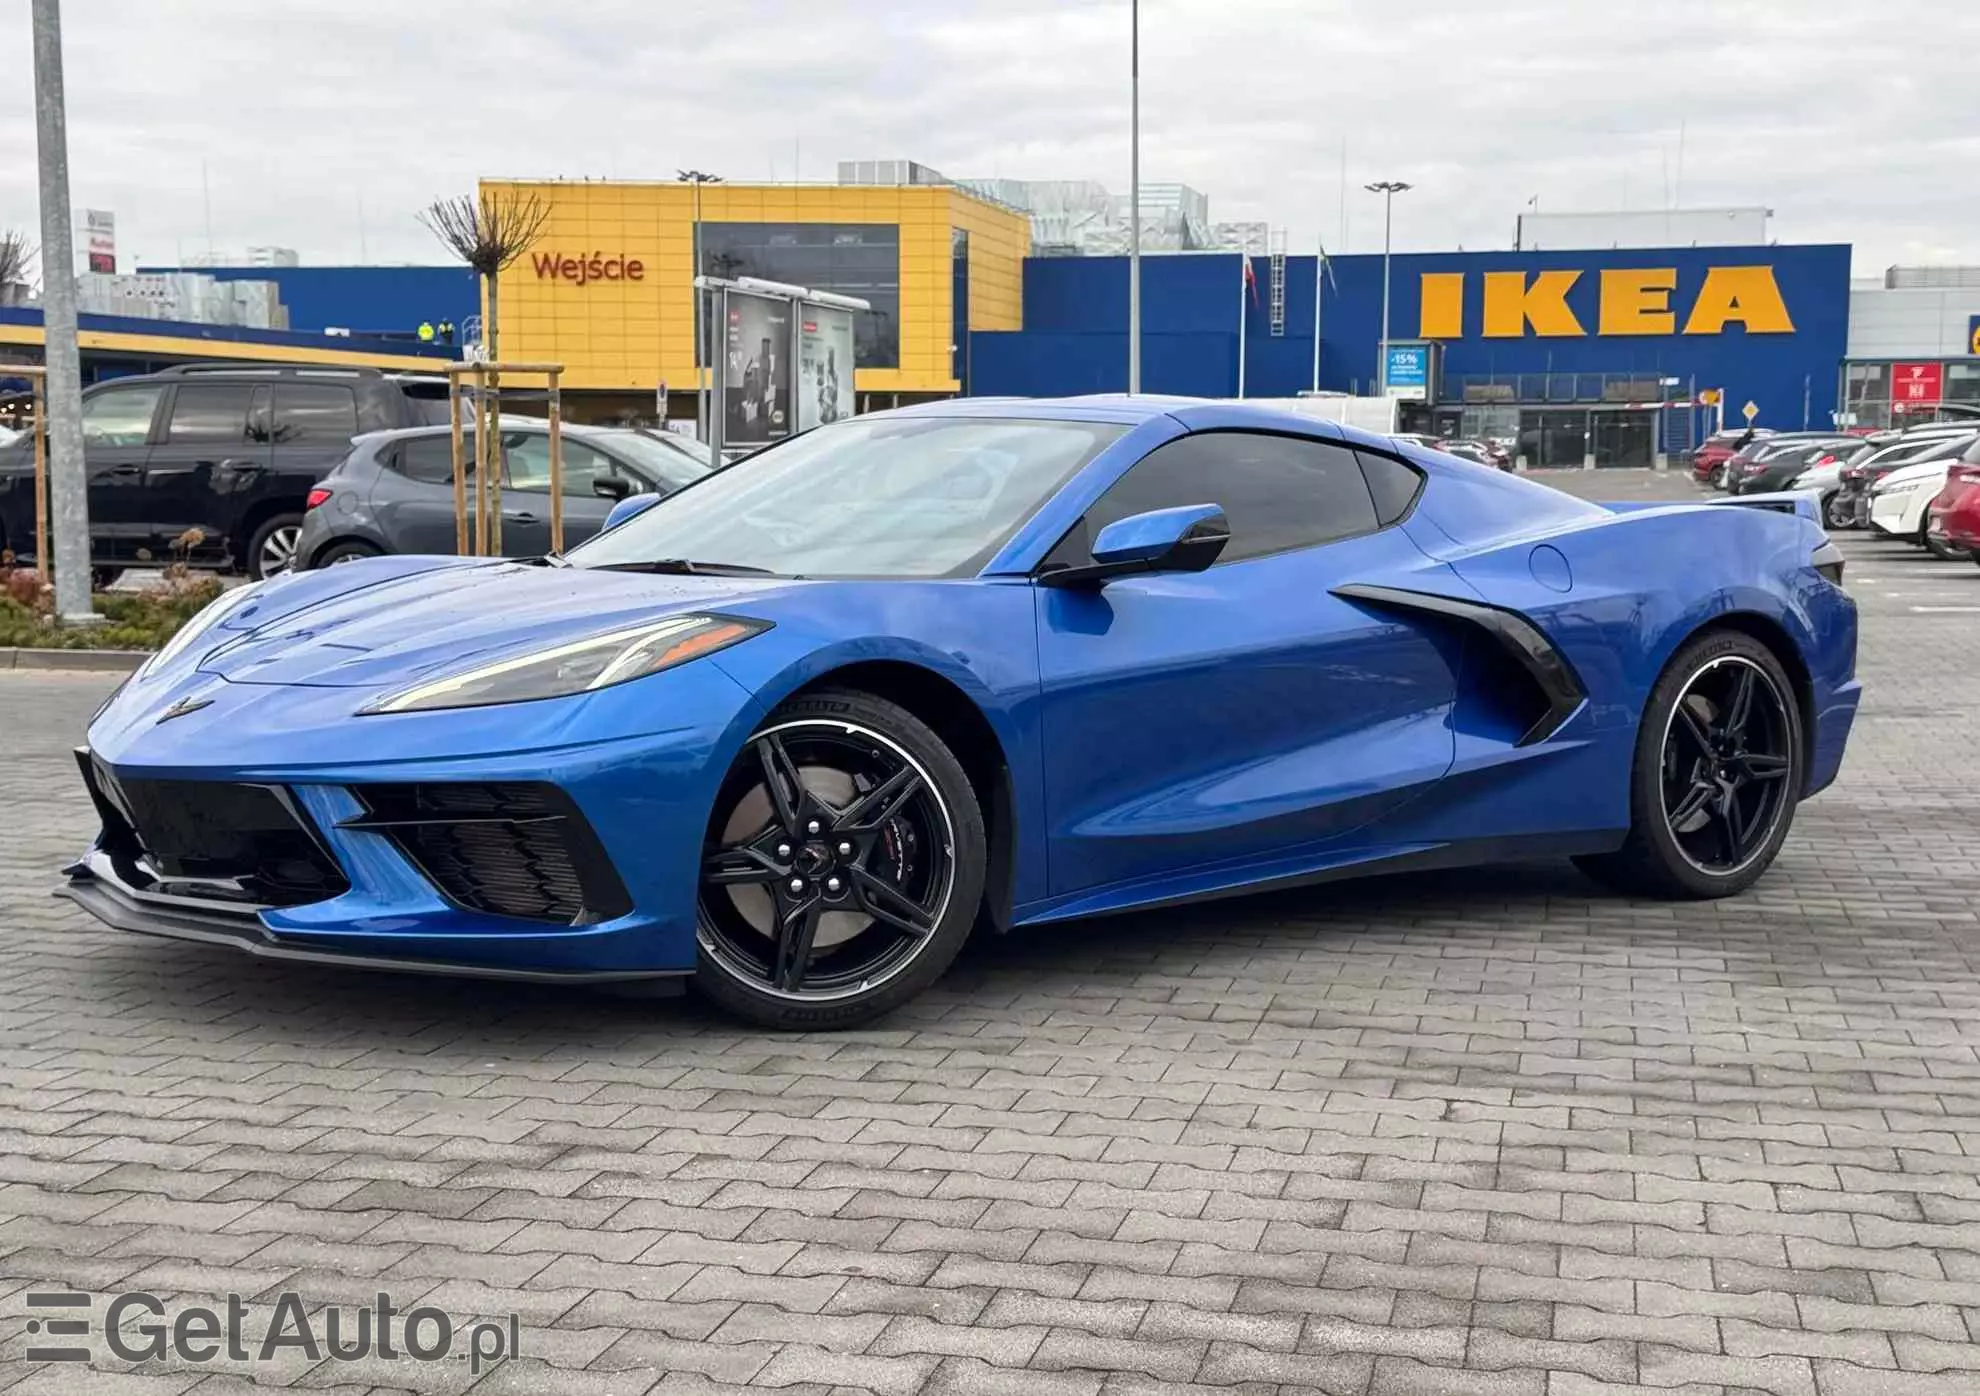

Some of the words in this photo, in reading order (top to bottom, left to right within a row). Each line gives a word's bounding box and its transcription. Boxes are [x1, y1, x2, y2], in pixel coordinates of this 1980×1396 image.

[532, 250, 644, 286] Wejście
[1419, 265, 1796, 338] IKEA
[1391, 353, 1418, 365] -15%
